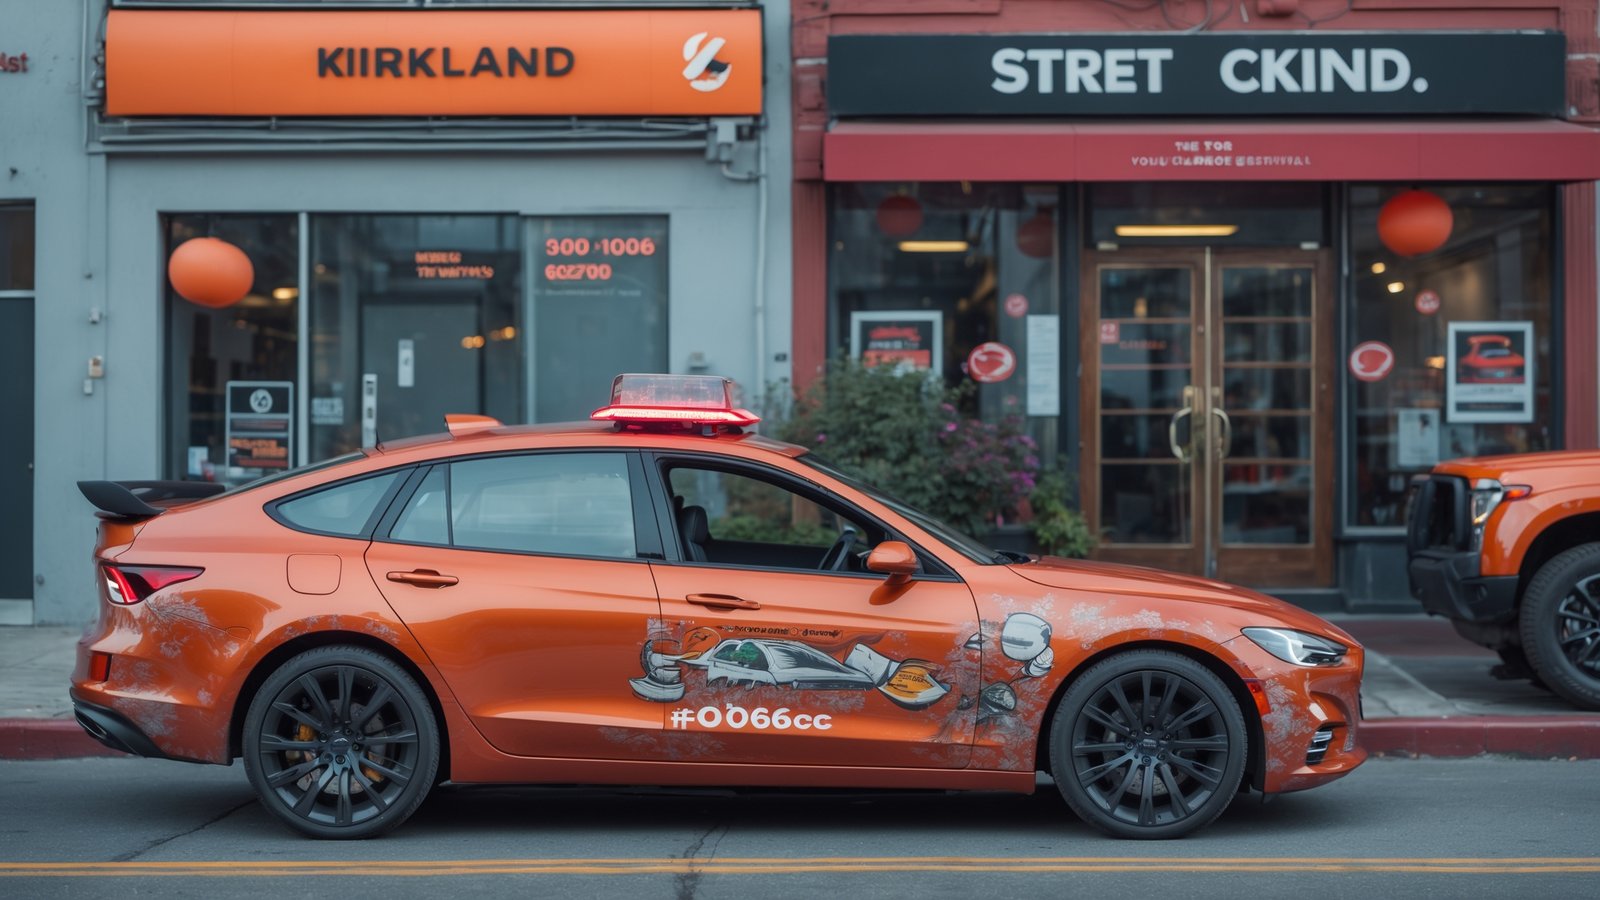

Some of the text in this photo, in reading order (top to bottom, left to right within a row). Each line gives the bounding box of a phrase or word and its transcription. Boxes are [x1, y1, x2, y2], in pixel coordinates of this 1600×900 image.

[318, 46, 575, 78] KIIRKLAND
[991, 47, 1430, 94] STRET CKIND.
[545, 237, 590, 256] 300
